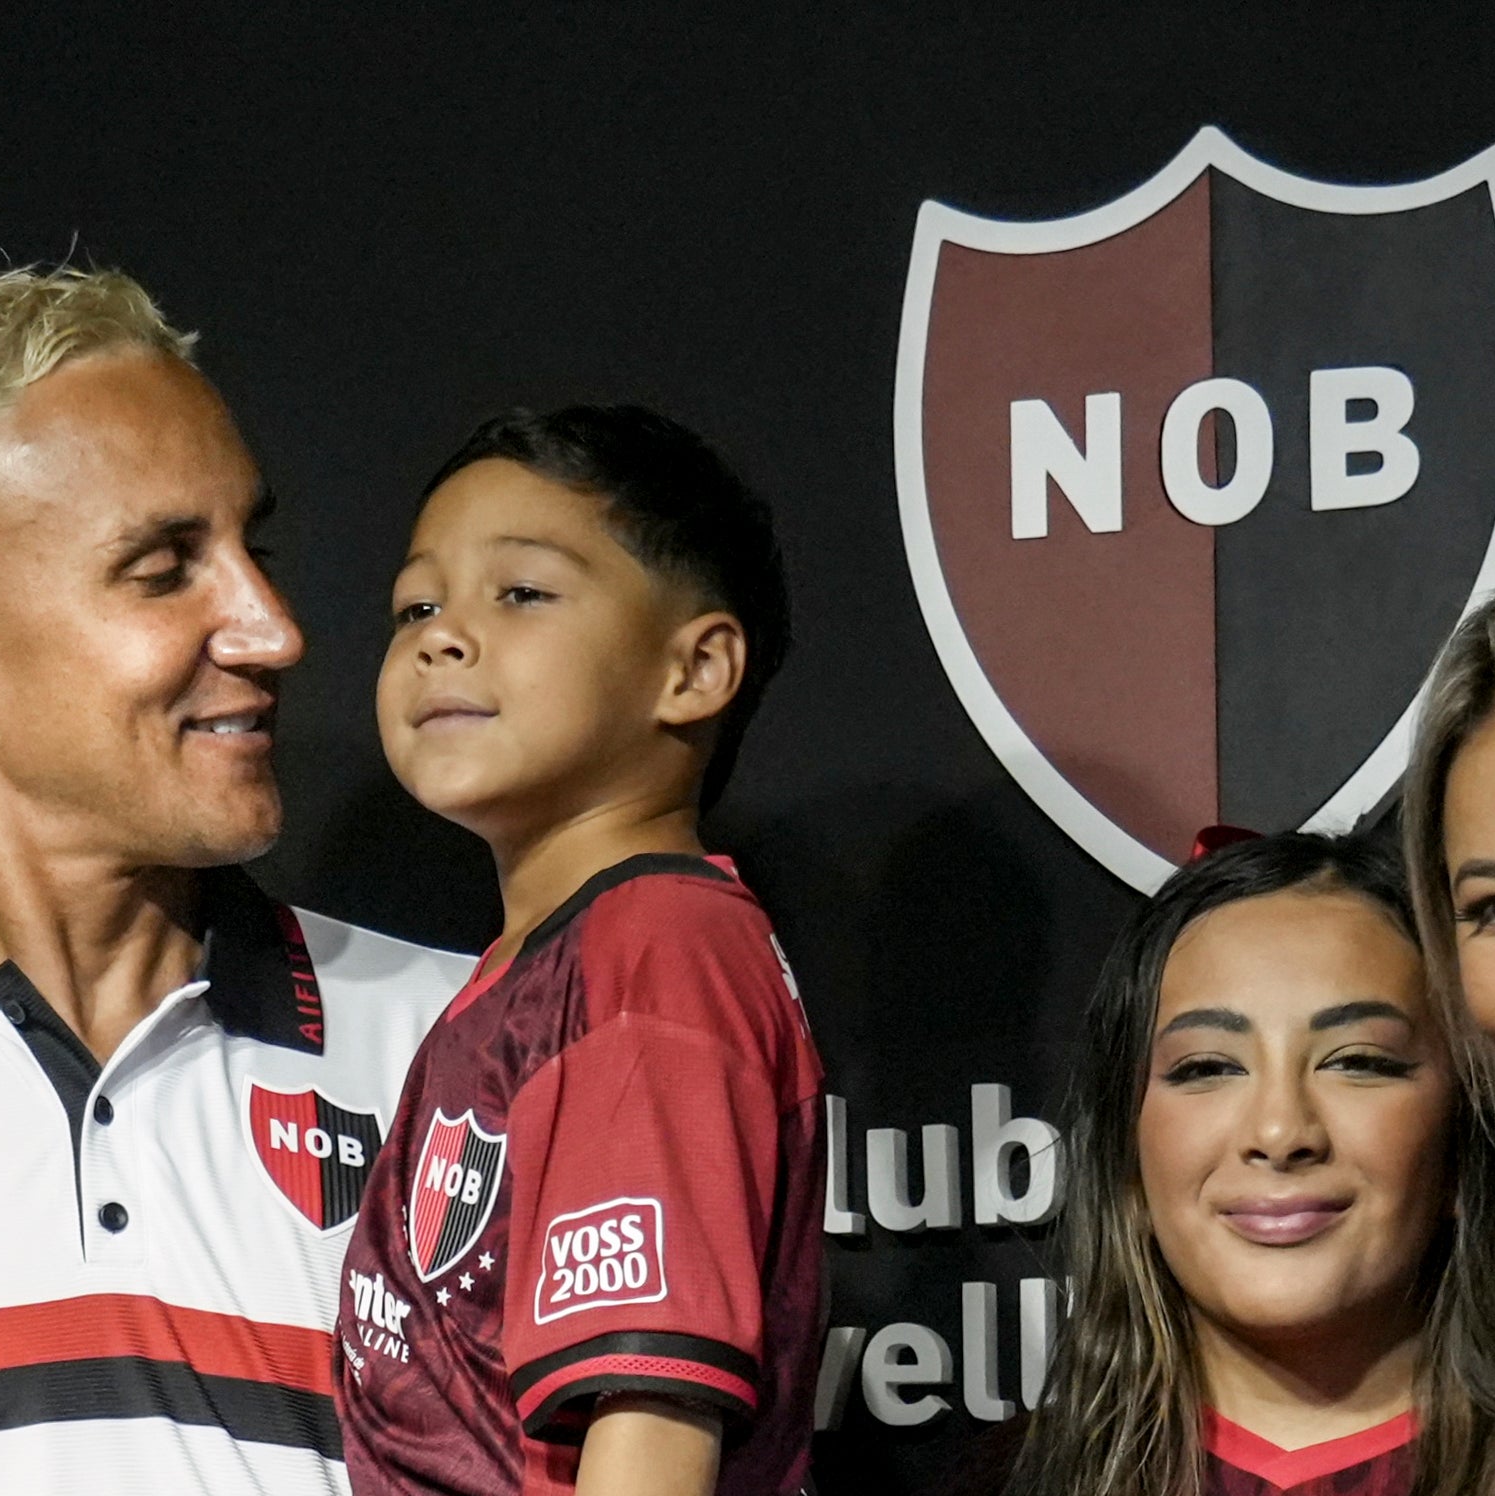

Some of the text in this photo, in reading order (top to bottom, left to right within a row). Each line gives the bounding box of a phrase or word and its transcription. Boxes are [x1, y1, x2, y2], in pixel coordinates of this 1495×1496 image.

[1010, 366, 1420, 539] NOB
[269, 1118, 365, 1168] NOB
[425, 1155, 483, 1205] NOB
[550, 1214, 644, 1268] VOSS
[550, 1252, 648, 1304] 2000
